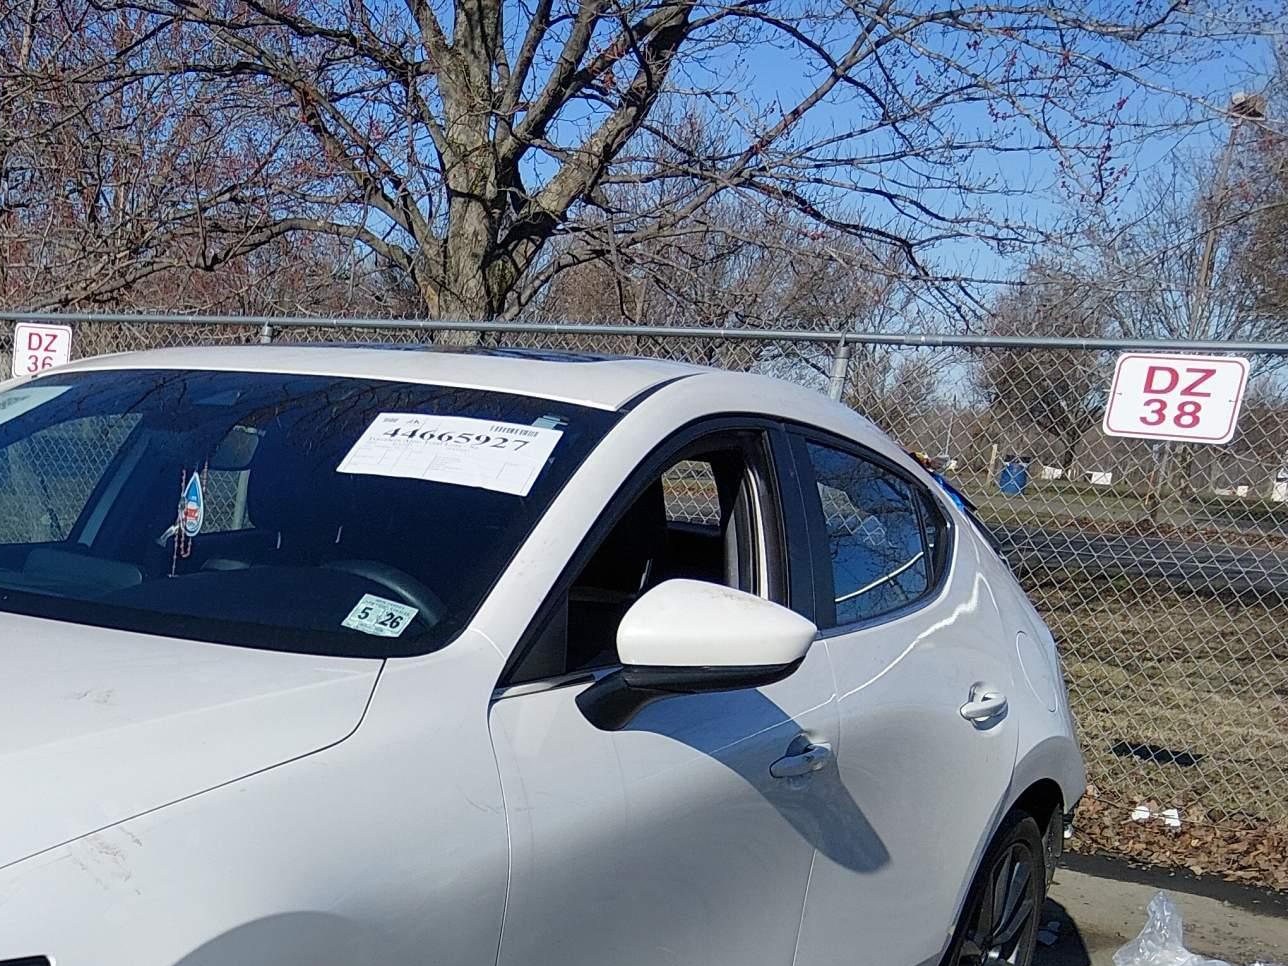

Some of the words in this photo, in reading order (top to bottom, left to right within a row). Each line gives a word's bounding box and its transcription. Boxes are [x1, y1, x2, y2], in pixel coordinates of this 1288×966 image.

[27, 332, 59, 353] DZ
[26, 354, 54, 373] 36
[1142, 365, 1218, 398] DZ
[1138, 398, 1202, 429] 38
[382, 427, 530, 452] 44665927
[357, 606, 374, 620] 5
[378, 612, 404, 629] 26
